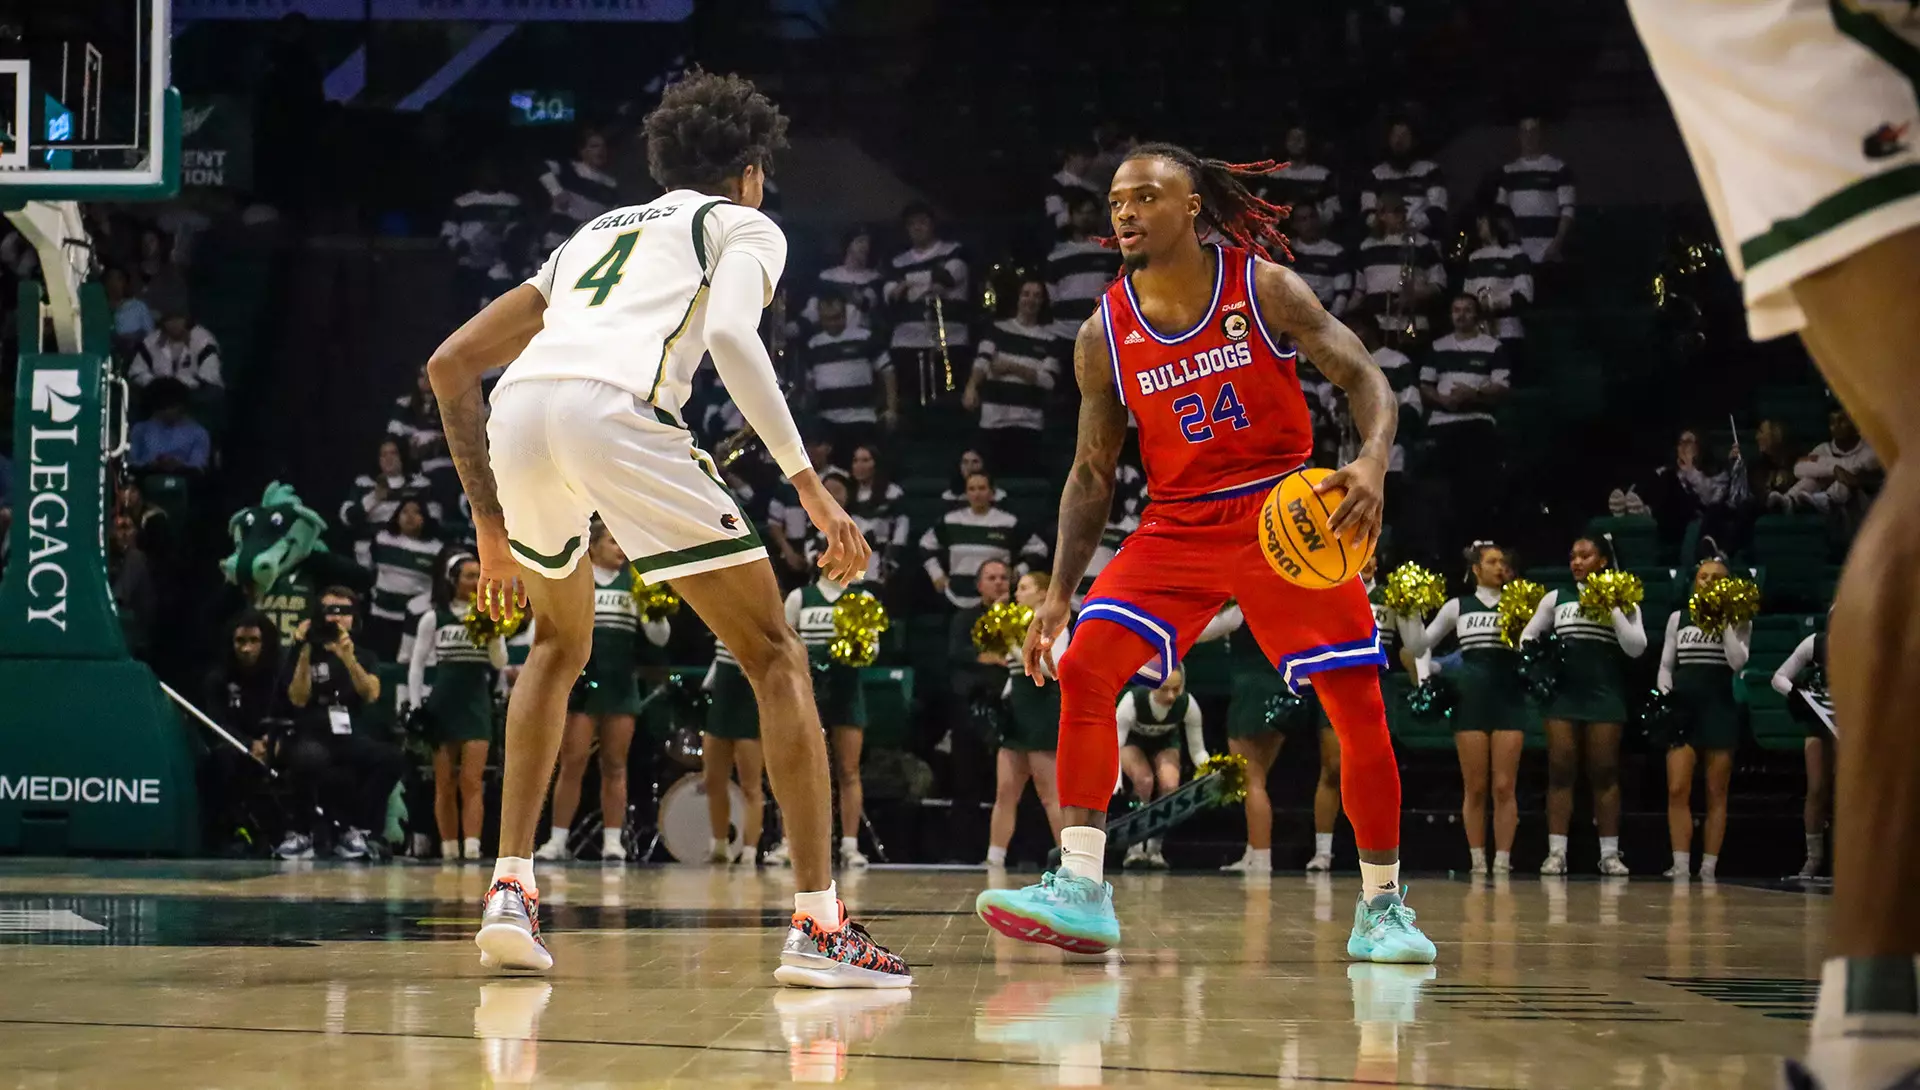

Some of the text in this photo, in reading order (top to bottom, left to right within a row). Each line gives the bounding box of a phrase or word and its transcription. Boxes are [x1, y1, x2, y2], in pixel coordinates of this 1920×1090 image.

[591, 203, 682, 231] GAINES
[571, 228, 643, 308] 4
[1136, 341, 1253, 396] BULLDOGS
[1172, 381, 1251, 444] 24
[27, 424, 78, 632] LEGACY
[1287, 497, 1326, 552] NCAA
[0, 774, 160, 804] MEDICINE
